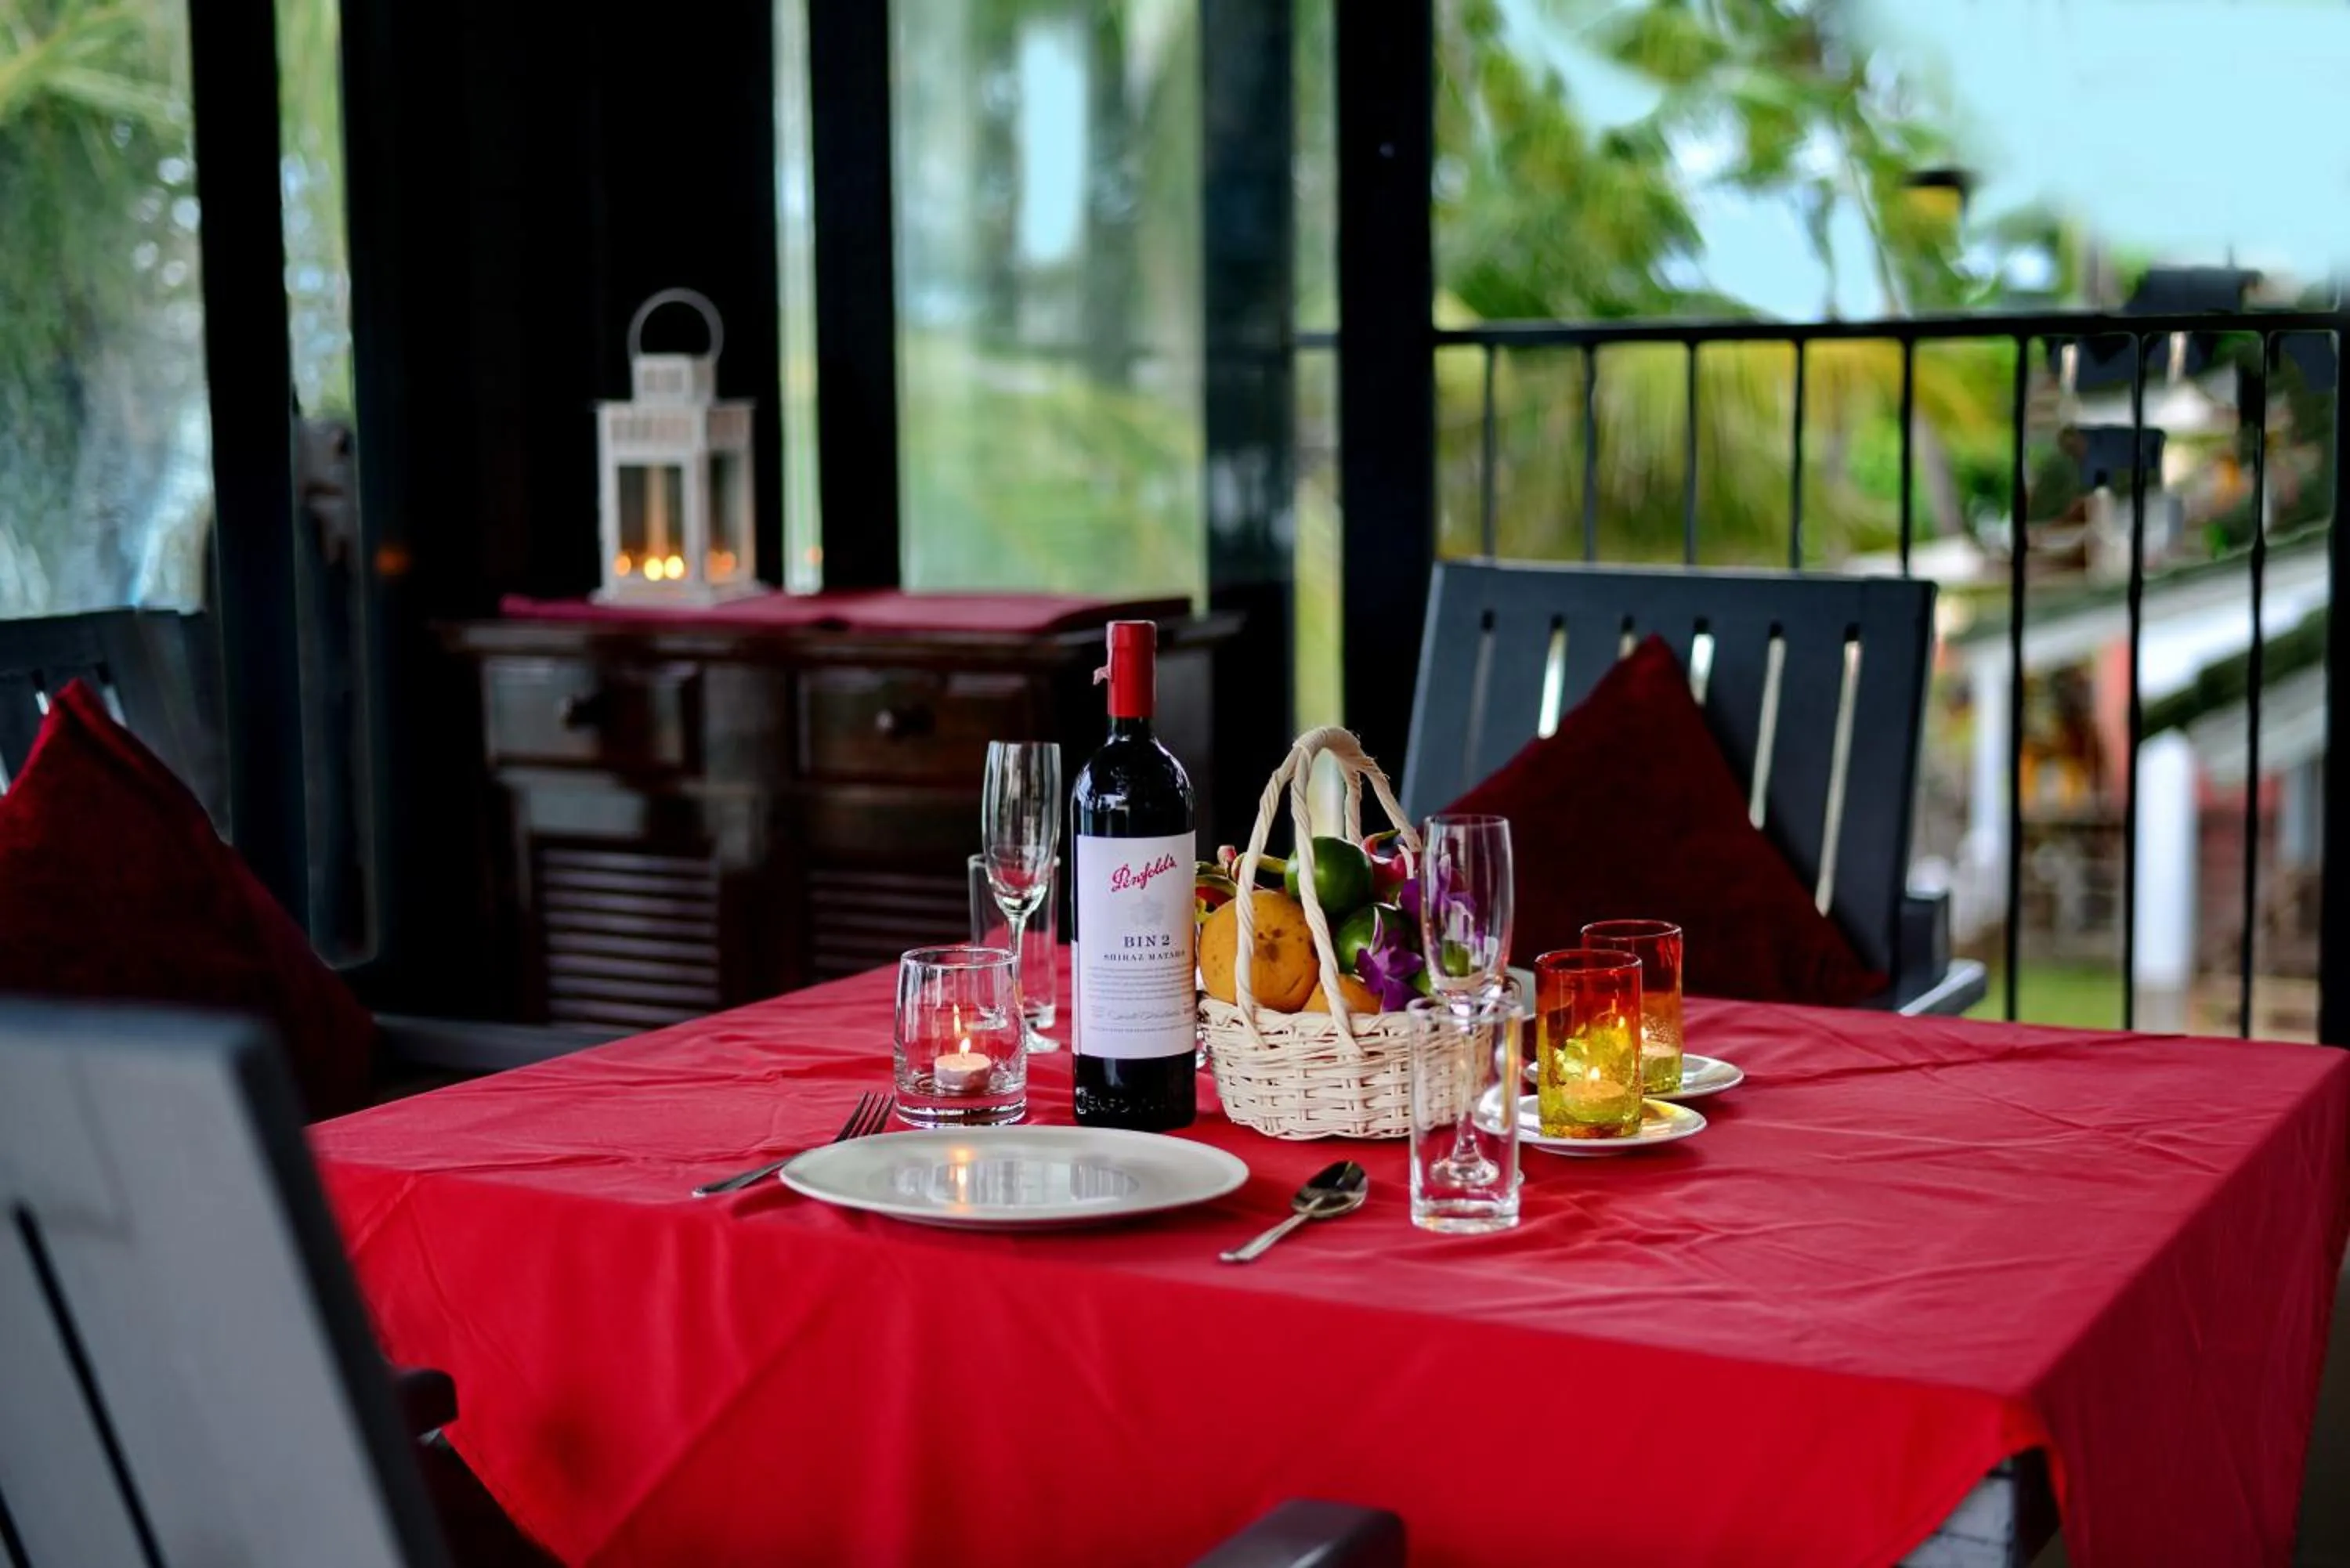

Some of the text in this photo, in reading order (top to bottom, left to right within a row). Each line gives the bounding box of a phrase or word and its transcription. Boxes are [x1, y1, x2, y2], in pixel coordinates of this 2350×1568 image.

[1112, 853, 1177, 892] Penfolds
[1124, 934, 1170, 948] BIN 2
